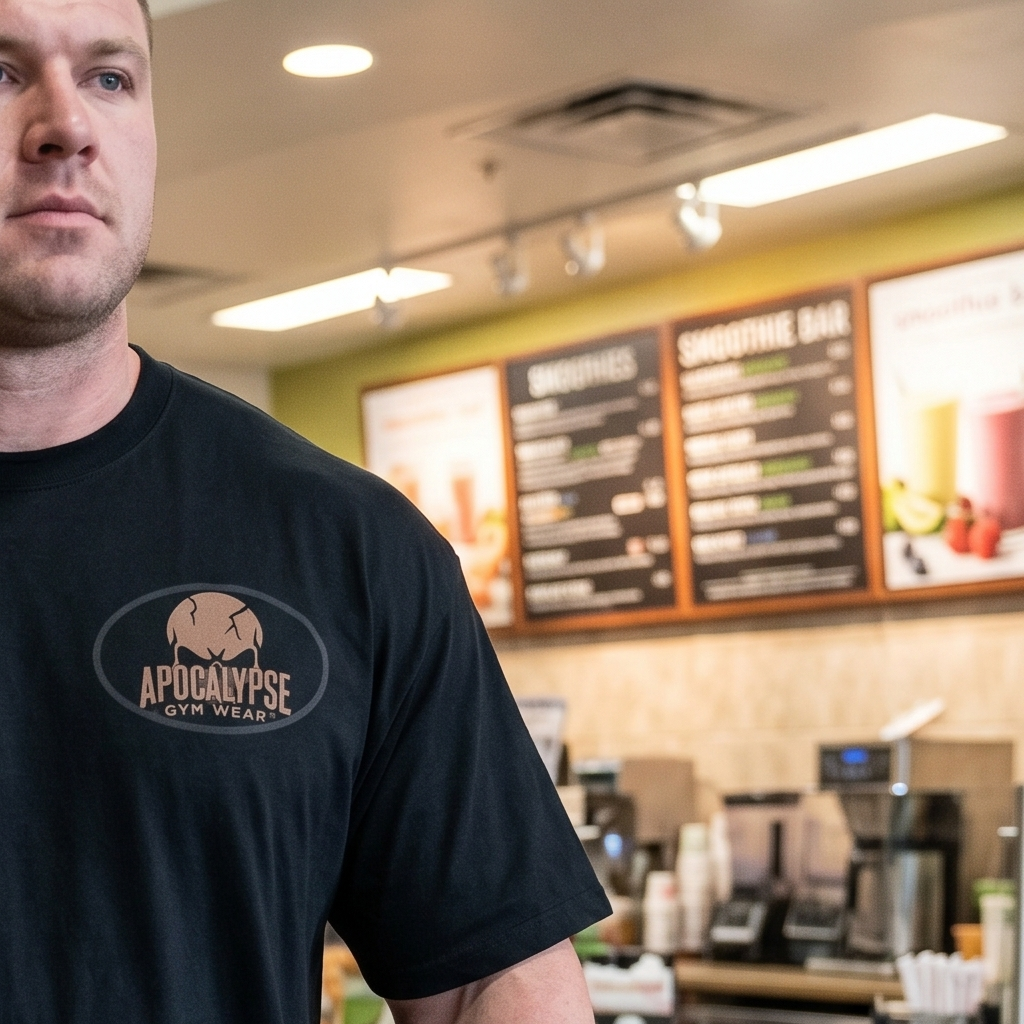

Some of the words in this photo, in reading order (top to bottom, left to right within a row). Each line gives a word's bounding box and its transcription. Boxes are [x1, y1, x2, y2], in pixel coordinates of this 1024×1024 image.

[139, 664, 292, 716] APOCALYPSE
[164, 703, 204, 717] GYM
[214, 704, 266, 722] WEAR
